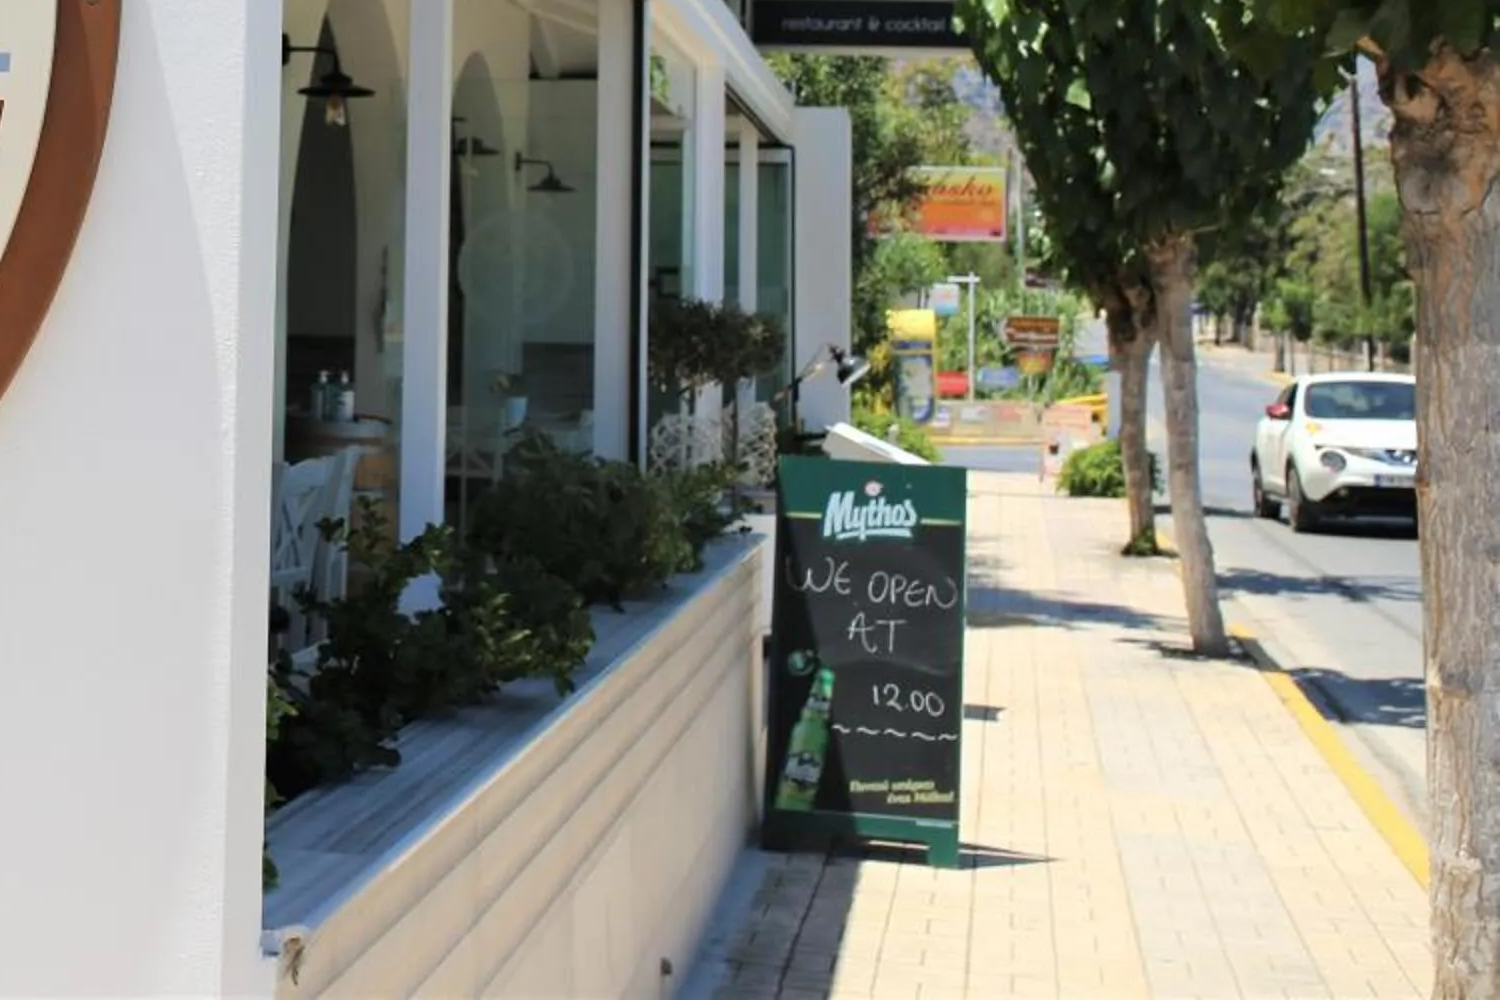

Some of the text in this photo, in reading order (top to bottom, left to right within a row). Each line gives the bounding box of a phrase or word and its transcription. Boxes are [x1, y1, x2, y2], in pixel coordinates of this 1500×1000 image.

[823, 491, 917, 540] Mythos
[785, 555, 958, 609] WE OPEN
[847, 612, 907, 653] AT
